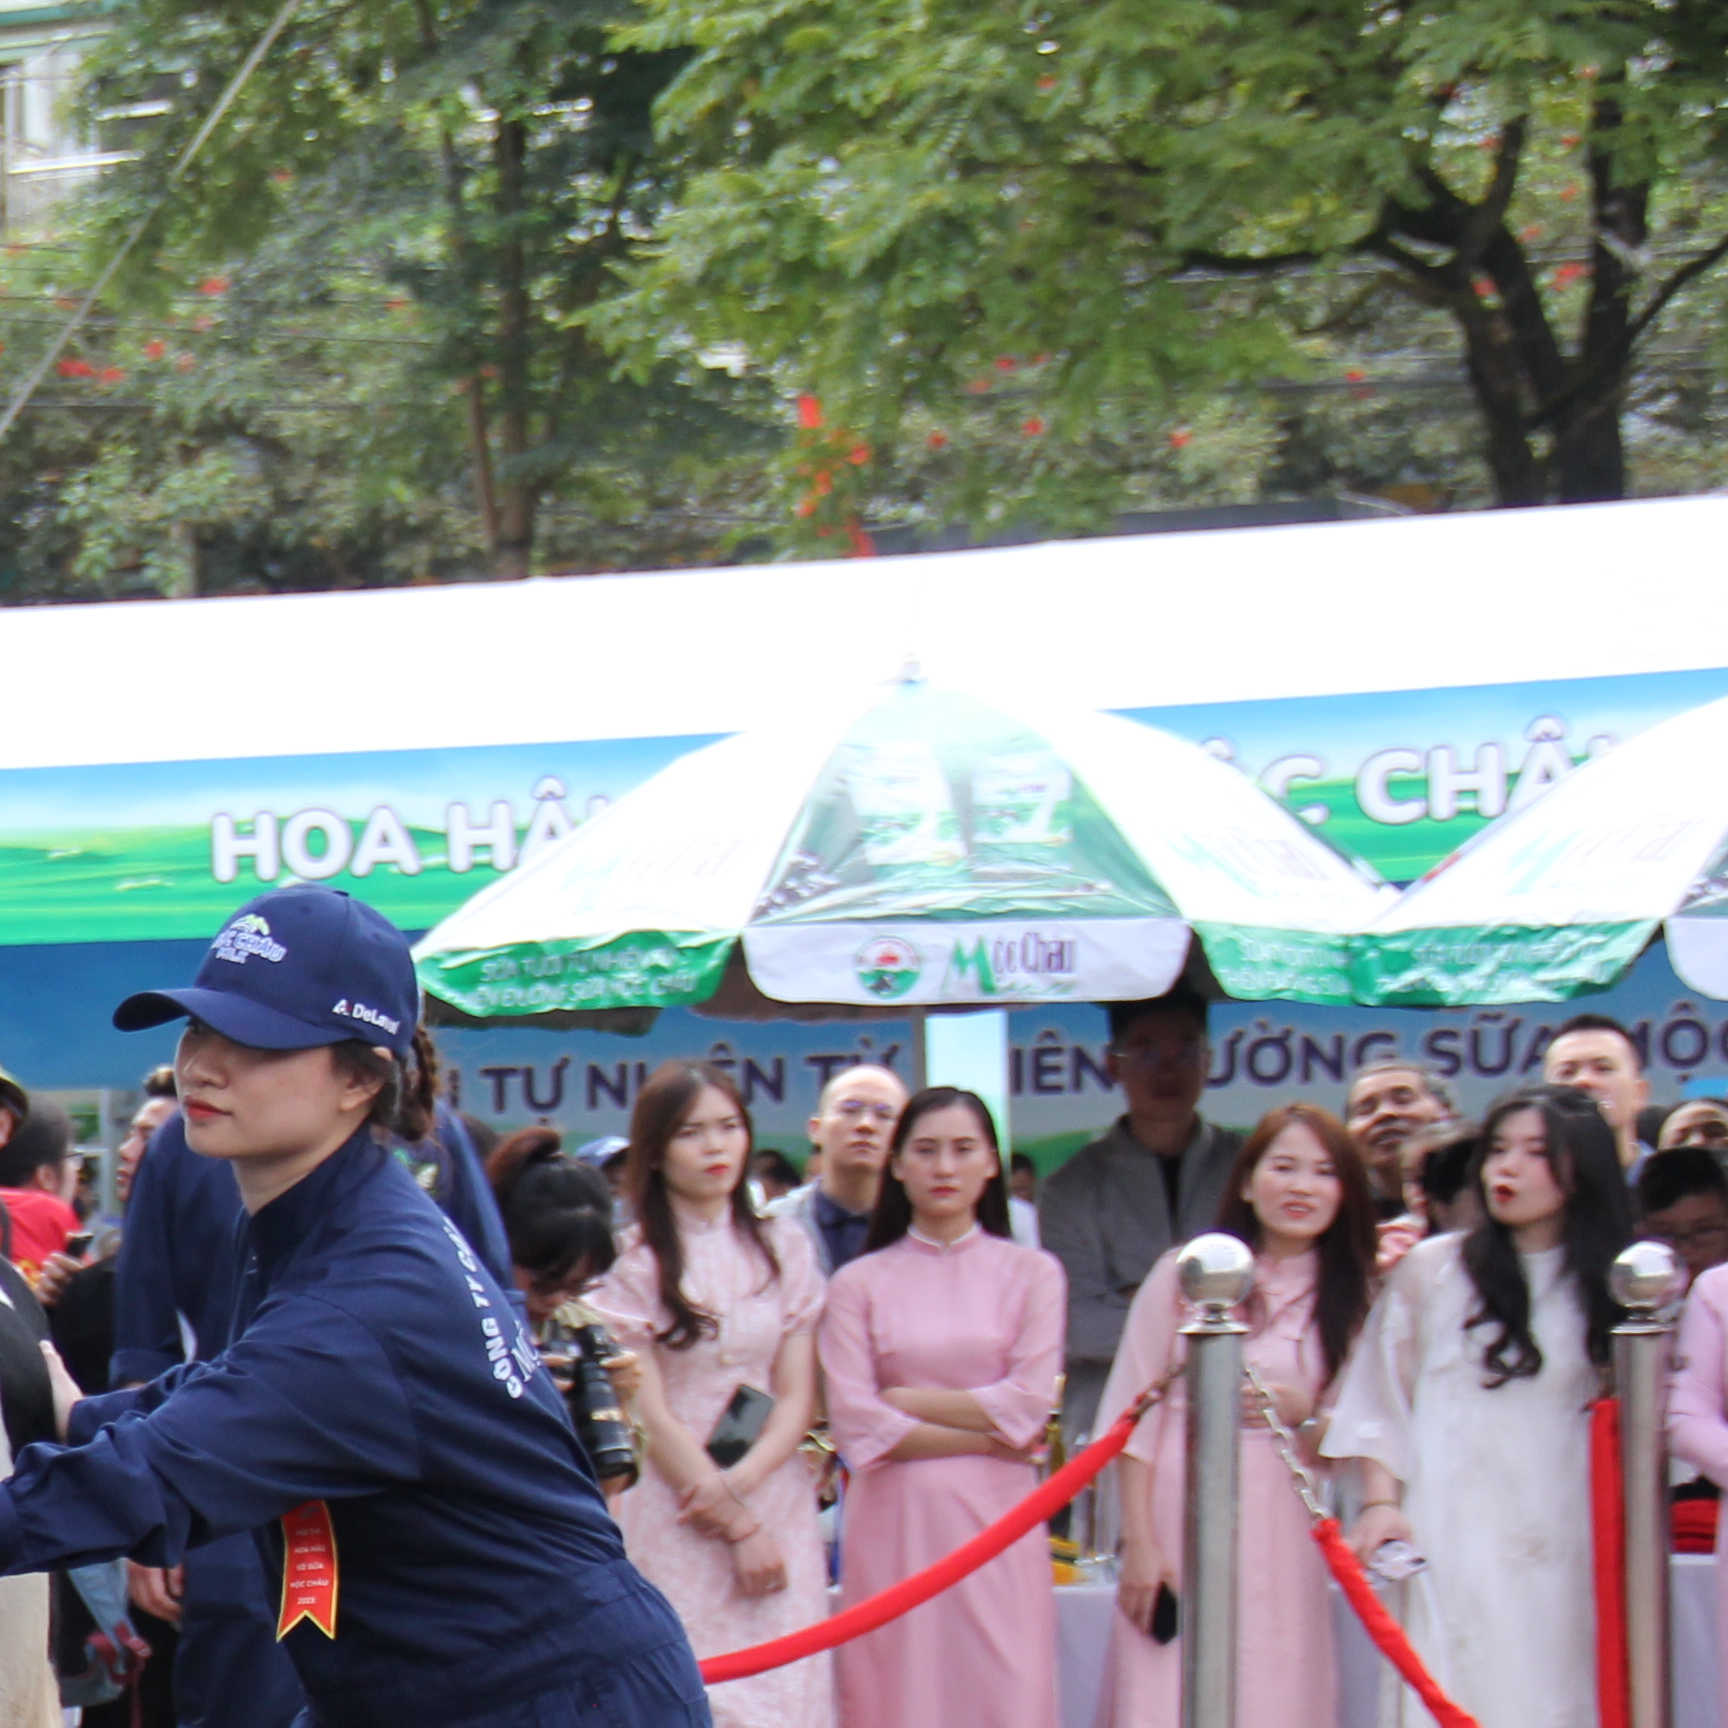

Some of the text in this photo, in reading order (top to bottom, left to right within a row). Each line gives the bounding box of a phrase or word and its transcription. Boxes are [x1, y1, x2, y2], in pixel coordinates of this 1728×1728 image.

[1356, 715, 1619, 825] CHÂ
[210, 803, 423, 884] HOA
[352, 1003, 401, 1036] DeLaval
[480, 1054, 572, 1127] TỰ
[464, 1274, 491, 1309] TY
[481, 1317, 523, 1399] CÔNG
